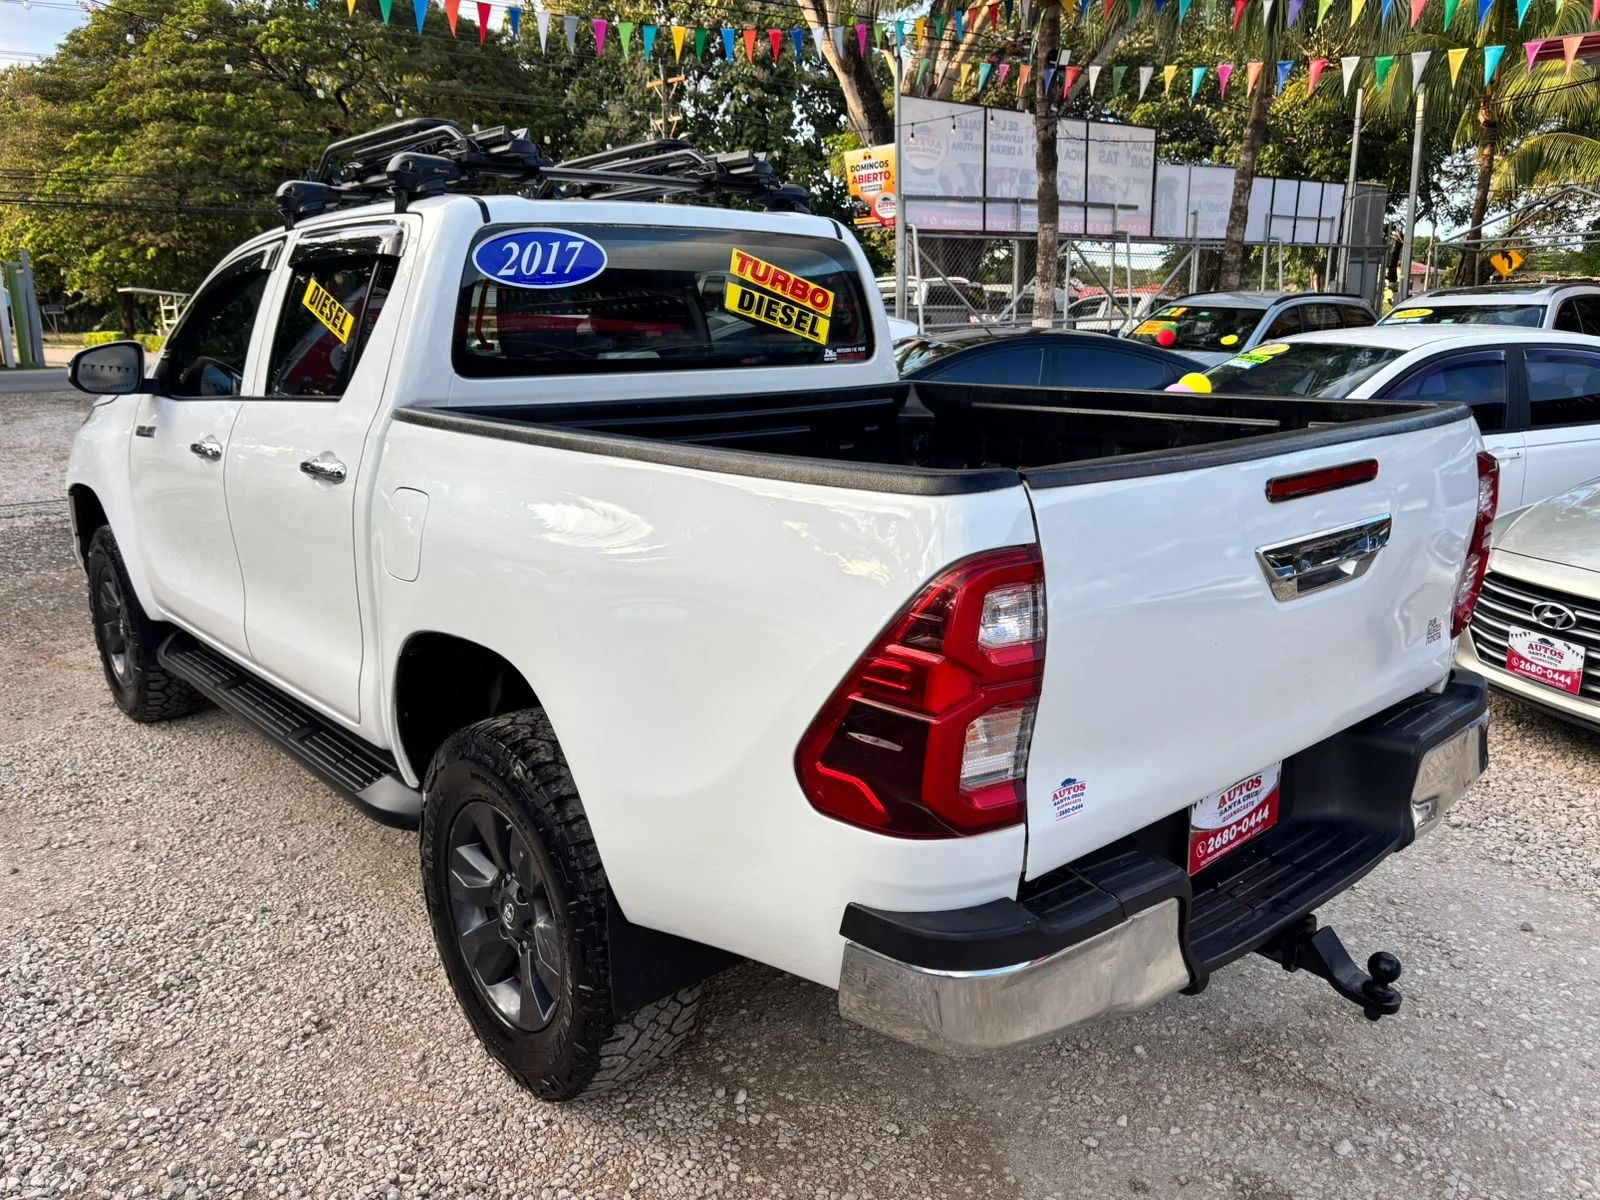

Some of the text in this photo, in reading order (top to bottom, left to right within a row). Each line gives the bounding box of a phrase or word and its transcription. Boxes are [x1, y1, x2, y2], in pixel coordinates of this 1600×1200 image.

[850, 160, 889, 173] DOMINGOS
[852, 171, 891, 185] ABIERTO
[497, 241, 585, 276] 2017
[735, 251, 831, 312] TURBO
[309, 285, 348, 336] DIESEL
[737, 288, 822, 340] DIESEL
[1527, 642, 1565, 660] AUTOS
[1528, 650, 1546, 659] SANTA
[1519, 660, 1572, 685] 2680-0444
[1052, 783, 1086, 801] AUTOS
[1217, 775, 1262, 810] AUTOS
[1219, 797, 1242, 816] SANTA
[1222, 799, 1255, 823] GUANACASTE
[1207, 804, 1269, 854] 2680-0444
